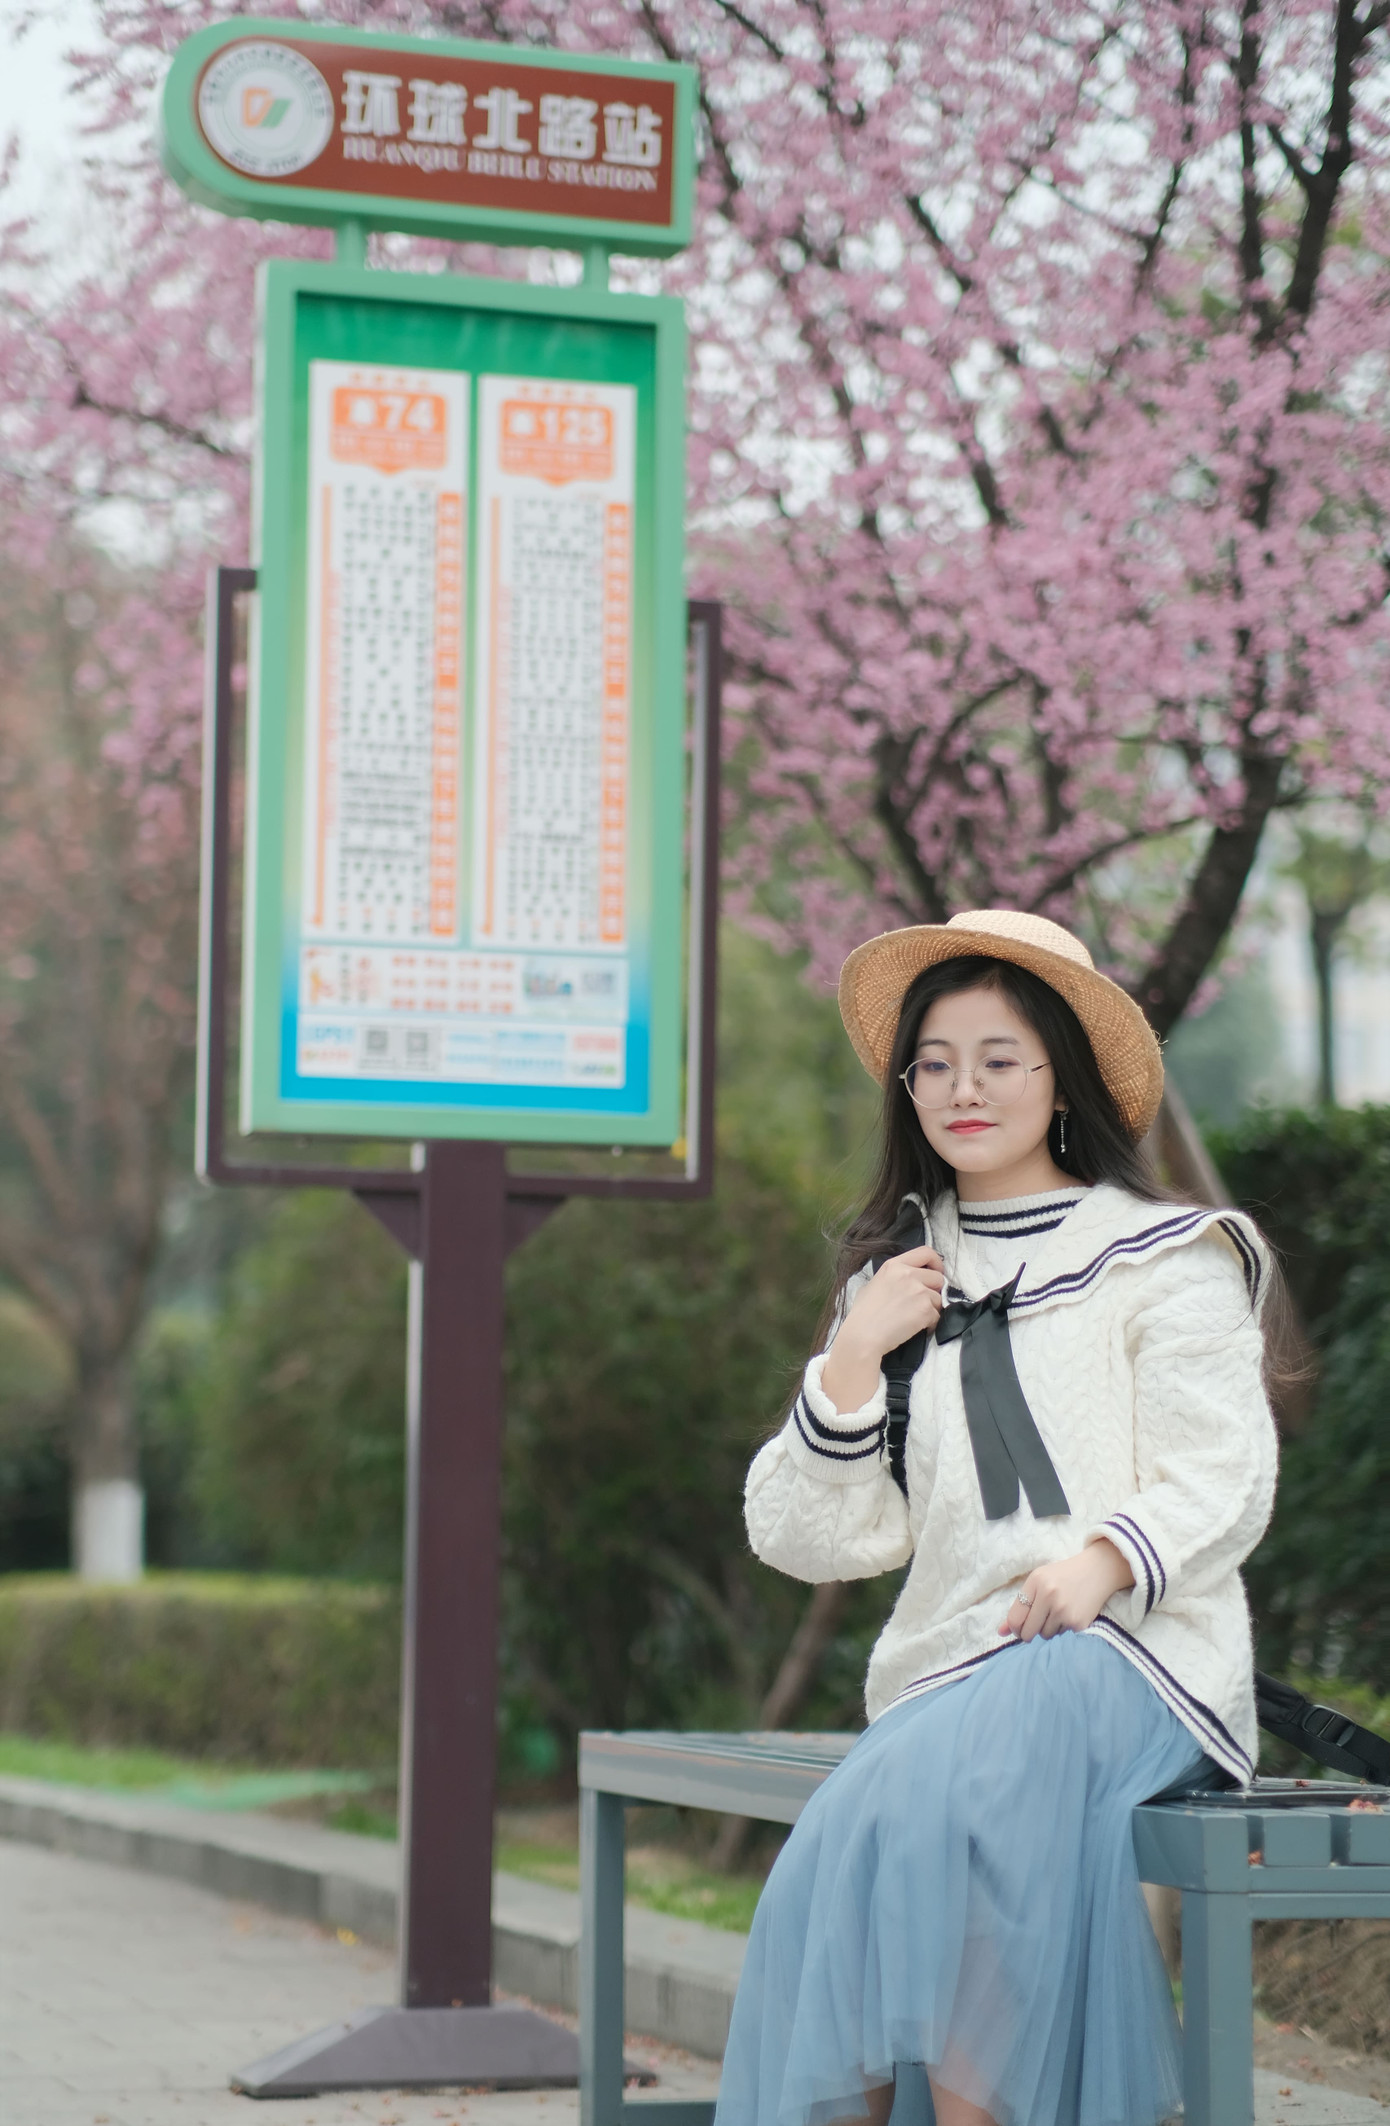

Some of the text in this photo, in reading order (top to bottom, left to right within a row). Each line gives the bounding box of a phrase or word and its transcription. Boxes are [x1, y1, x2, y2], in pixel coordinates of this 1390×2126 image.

[340, 70, 663, 167] 环球北路站
[548, 160, 658, 192] STATION
[379, 396, 435, 435] 74
